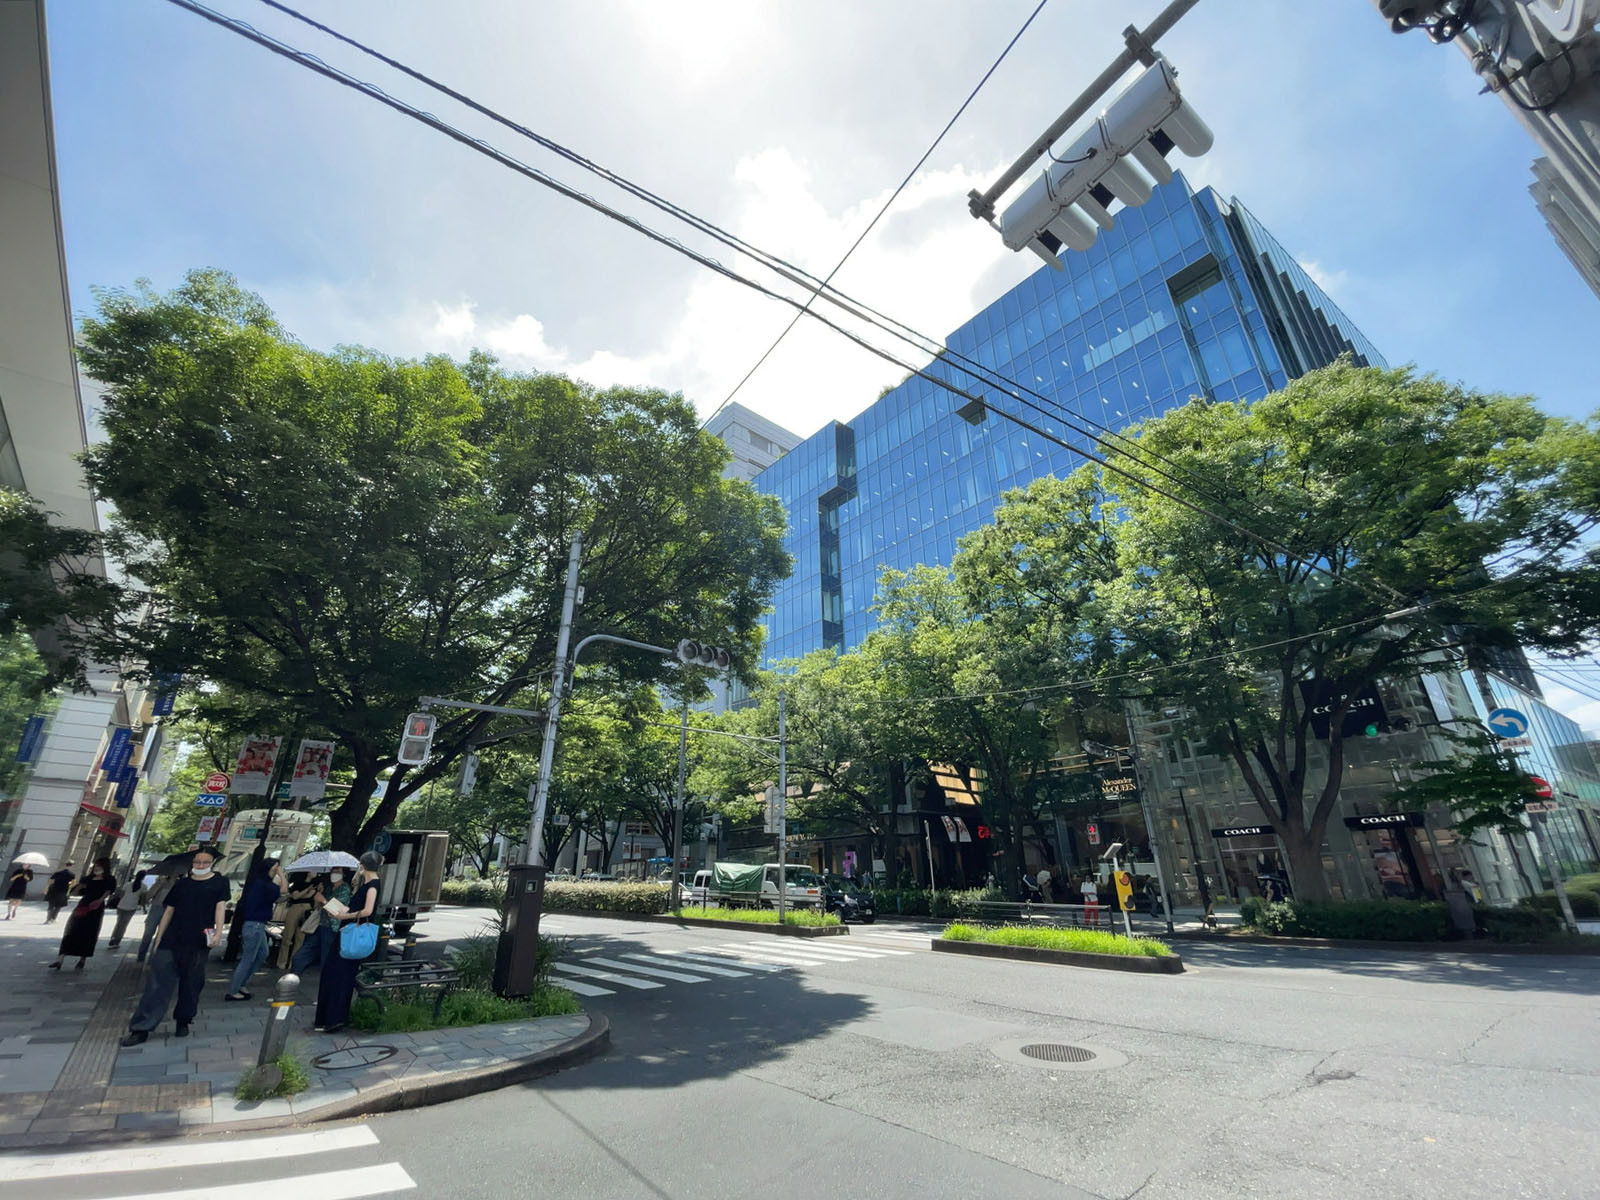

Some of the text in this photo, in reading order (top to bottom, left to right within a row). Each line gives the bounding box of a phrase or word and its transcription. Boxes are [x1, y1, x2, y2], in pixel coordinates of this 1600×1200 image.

[1312, 697, 1375, 714] COCH
[1102, 777, 1133, 785] Alexander
[1360, 814, 1406, 824] COACH
[1224, 827, 1261, 835] COACH
